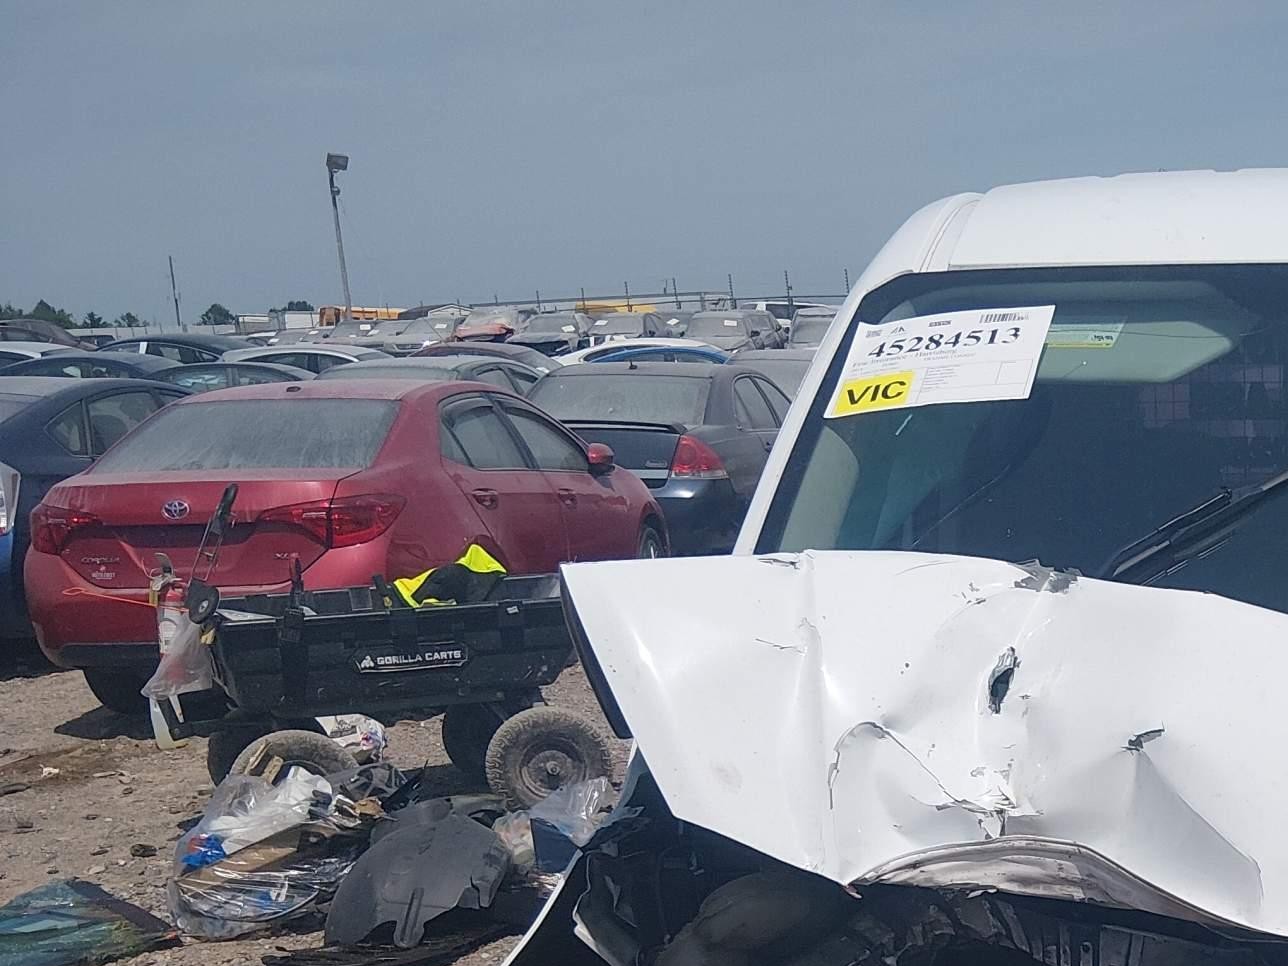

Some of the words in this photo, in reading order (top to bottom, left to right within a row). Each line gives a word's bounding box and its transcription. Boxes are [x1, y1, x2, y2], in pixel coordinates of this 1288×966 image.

[868, 327, 1021, 358] 45284513
[847, 381, 907, 405] VIC
[377, 654, 423, 665] GORILLA
[425, 650, 462, 661] CARTS
